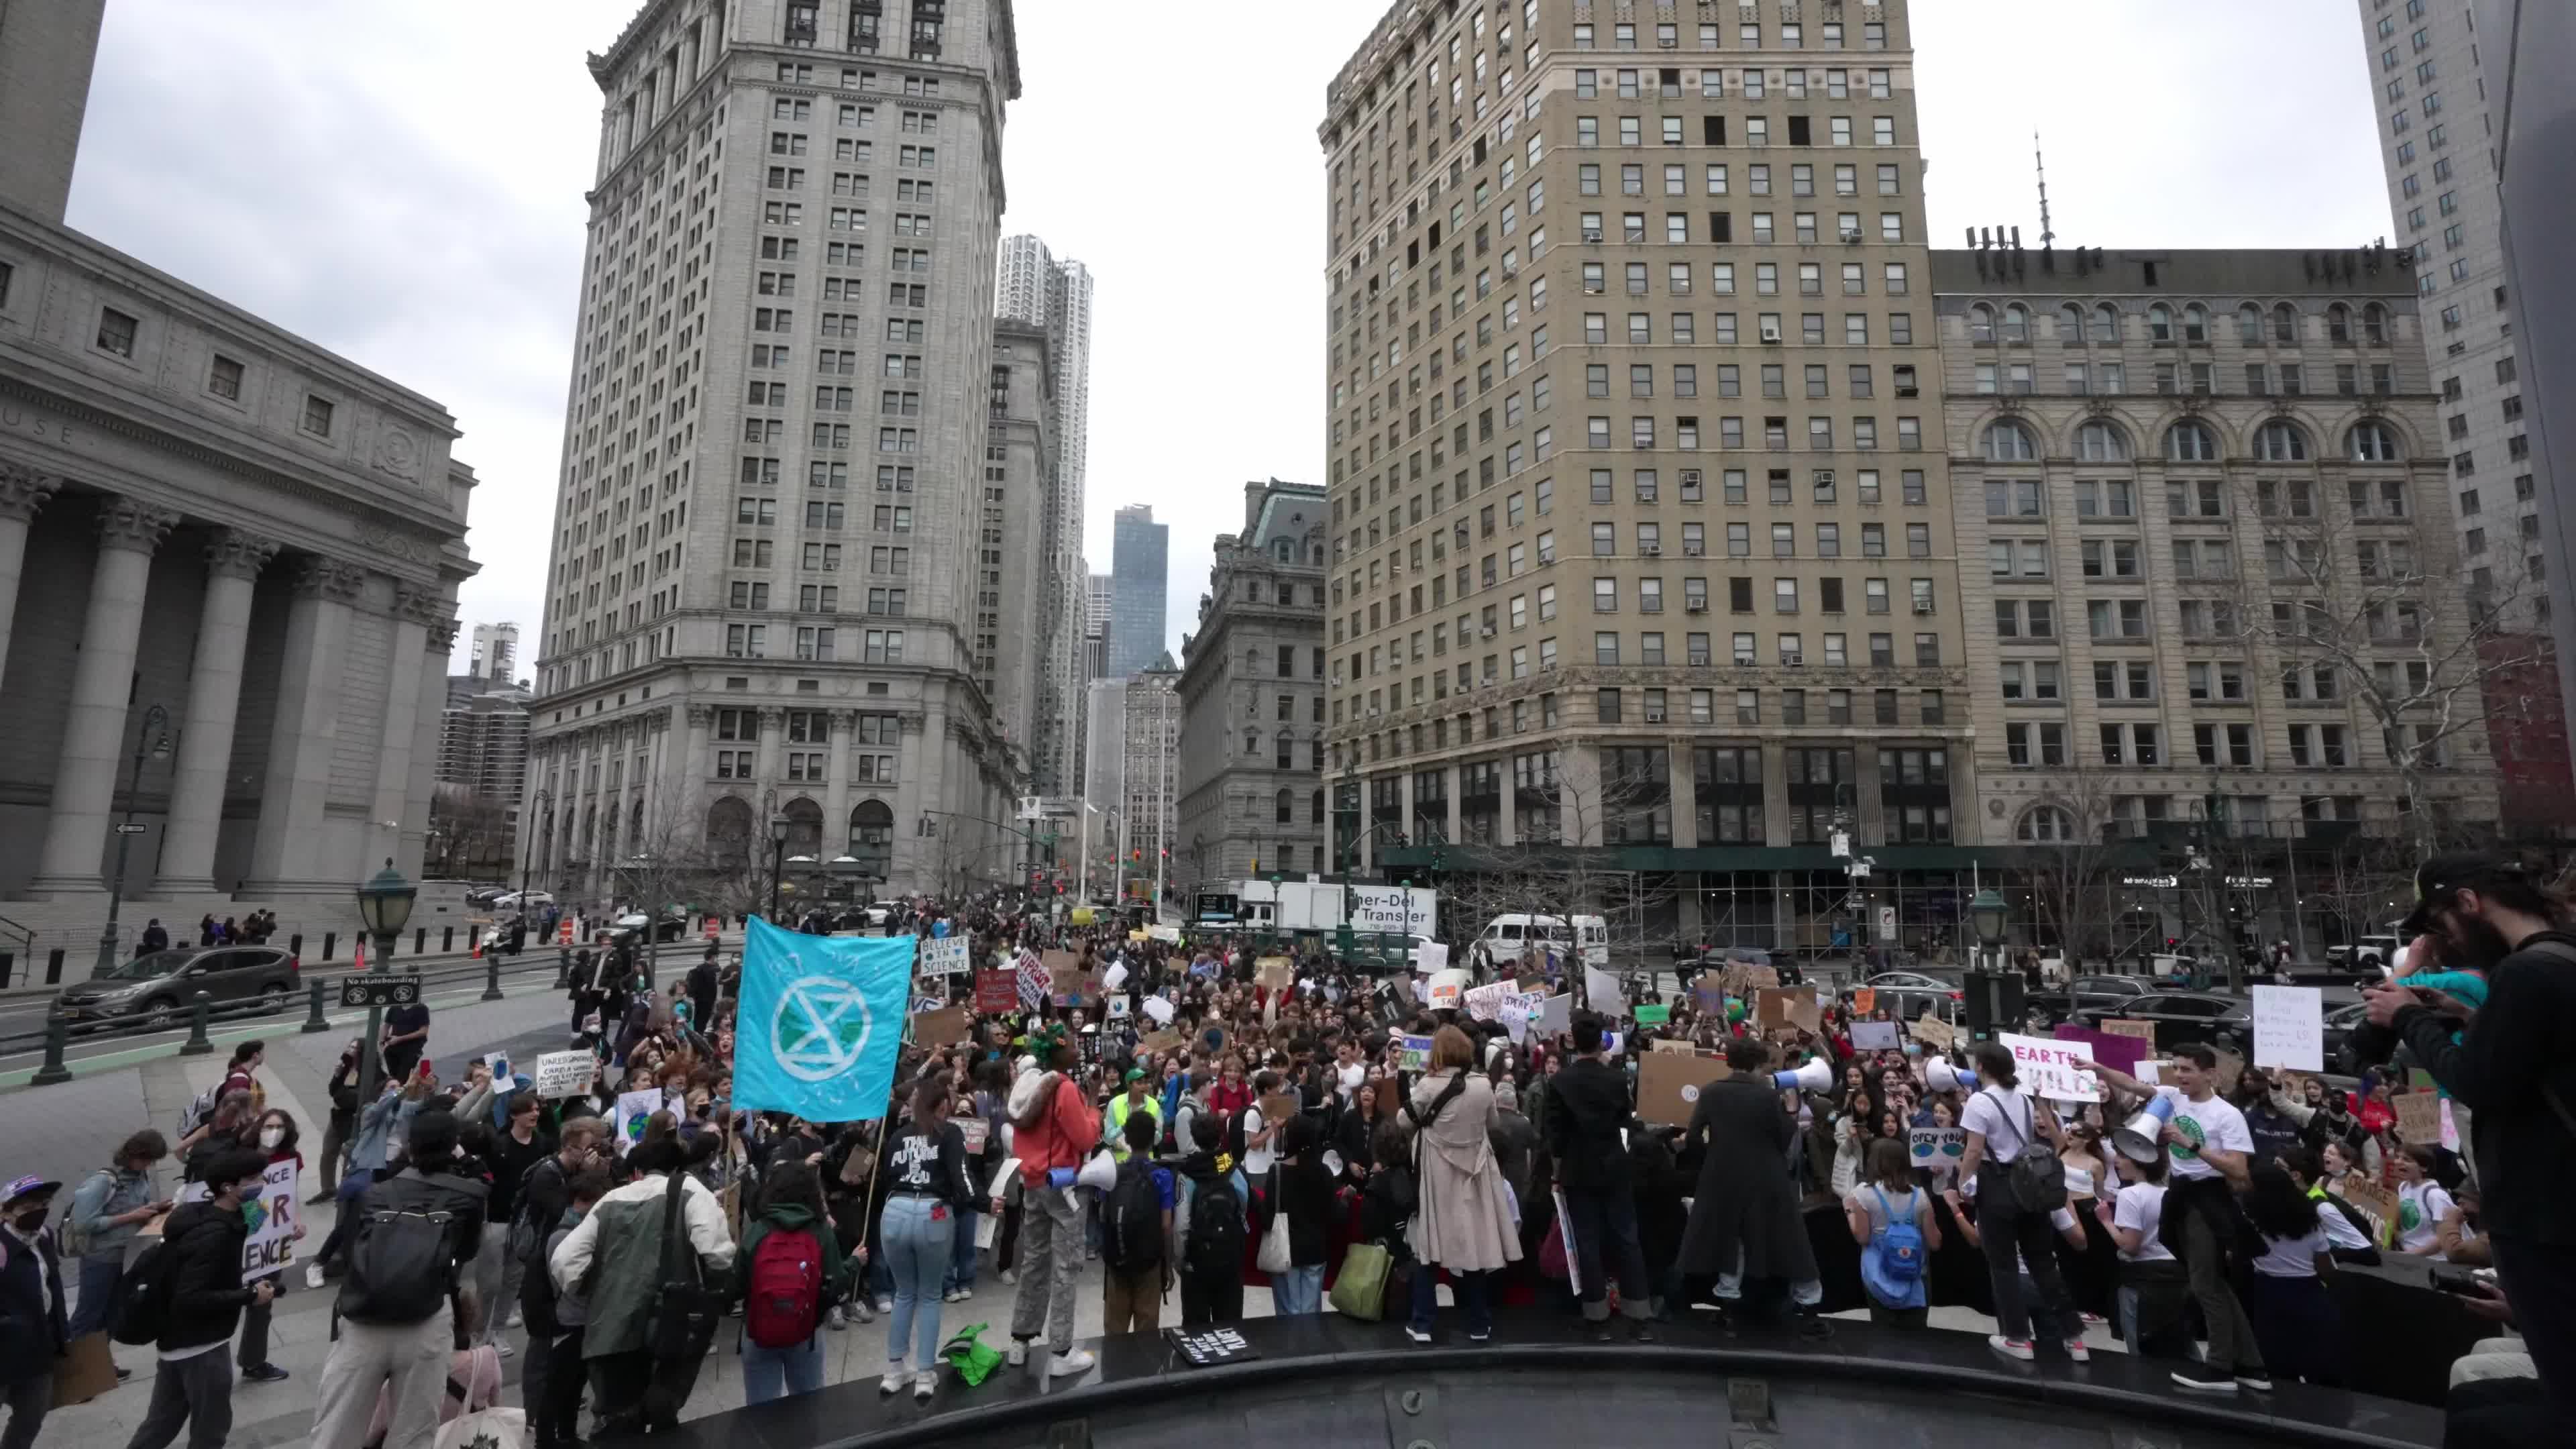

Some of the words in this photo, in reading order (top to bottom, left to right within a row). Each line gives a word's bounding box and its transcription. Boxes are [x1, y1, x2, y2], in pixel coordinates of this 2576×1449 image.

[1362, 908, 1426, 922] Transfer
[923, 937, 966, 951] BELIEVE
[937, 949, 949, 959] IN
[923, 959, 966, 975] SCIENCE
[360, 977, 418, 985] skateboarding
[2015, 1045, 2078, 1066] EARTH
[1913, 1132, 1938, 1144] OPEN
